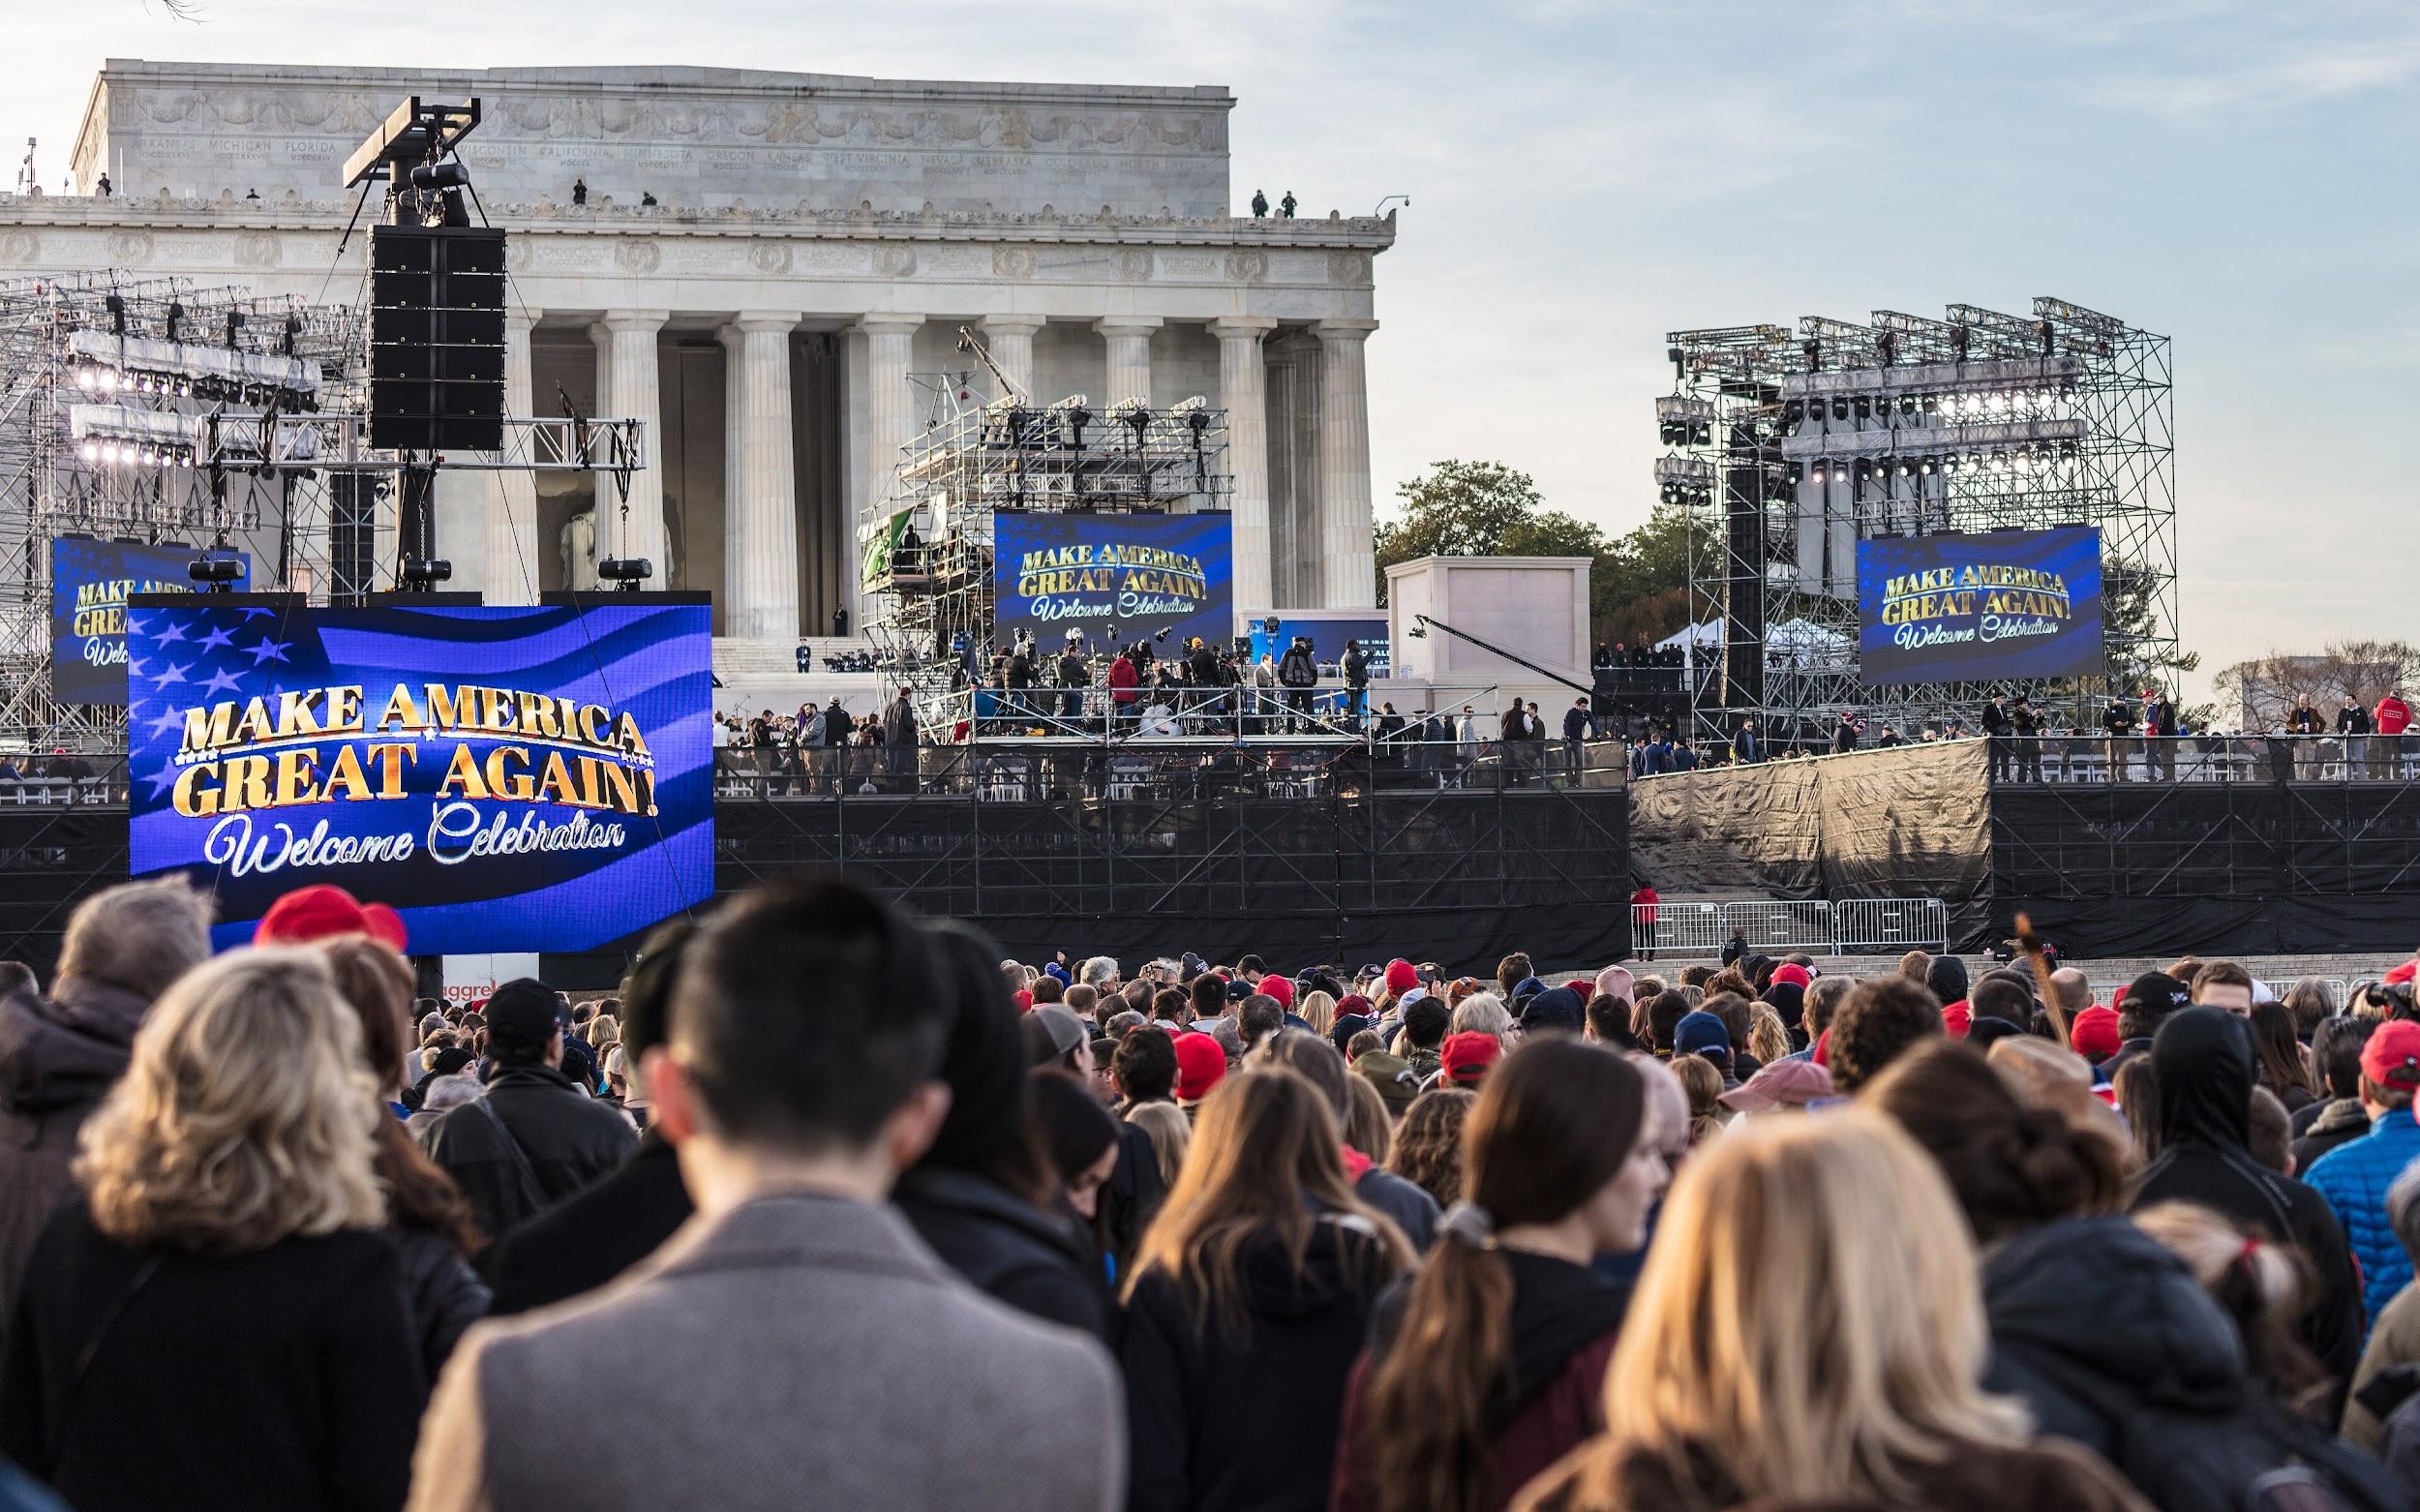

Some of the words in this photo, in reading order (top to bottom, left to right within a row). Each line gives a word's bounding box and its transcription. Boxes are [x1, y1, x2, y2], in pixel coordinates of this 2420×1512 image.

[132, 138, 196, 149] ARKANSAS
[209, 140, 271, 151] MICHIGAN
[285, 141, 336, 152] FLORIDA
[456, 145, 527, 156] WISCONSIN
[539, 147, 610, 158] CALIFORNIA
[706, 150, 755, 161] OREGON
[767, 152, 811, 163] KANSAS
[823, 153, 853, 164] WEST
[858, 154, 909, 165] VIRGINIA
[1162, 257, 1217, 269] VIRGINIA
[1022, 544, 1093, 571] MAKE
[1097, 544, 1204, 574] AMERICA
[1018, 569, 1114, 597] GREAT
[1121, 569, 1207, 600] AGAIN!
[1885, 567, 1954, 599] MAKE
[1960, 565, 2068, 593] AMERICA
[1031, 595, 1112, 621] Welcome
[1117, 592, 1195, 618] Celebration
[1882, 590, 1976, 625] GREAT
[1984, 590, 2072, 620] AGAIN!
[75, 608, 128, 637] GRE
[1894, 622, 1975, 650] Welcome
[1980, 615, 2058, 643] Celebration
[84, 636, 128, 667] Welc
[177, 684, 364, 753] MAKE
[377, 682, 651, 756] AMERICA
[172, 742, 418, 818] GREAT
[436, 742, 658, 817] AGAIN!
[203, 813, 415, 878] Welcome
[428, 801, 625, 864] Celebration
